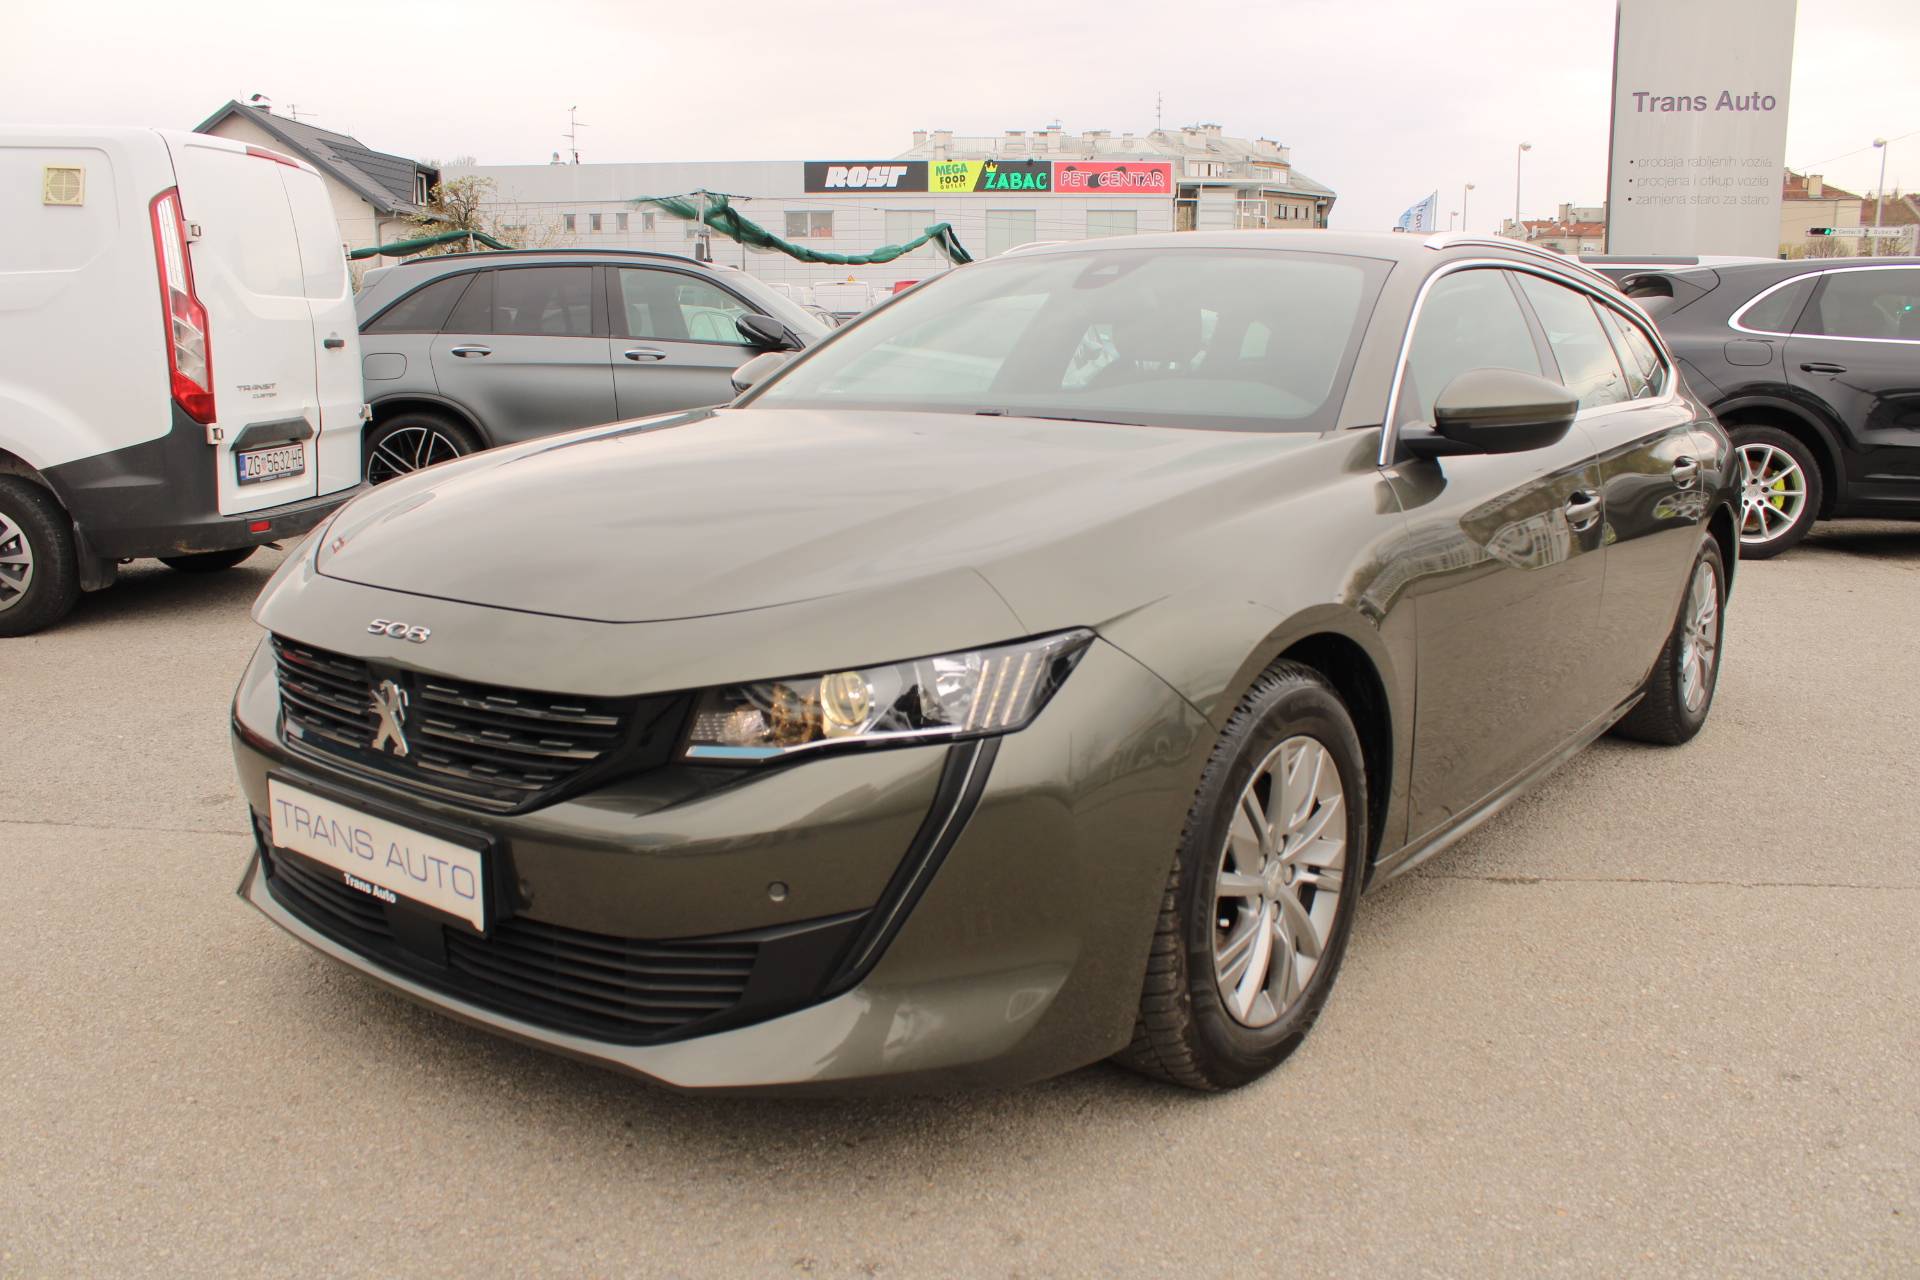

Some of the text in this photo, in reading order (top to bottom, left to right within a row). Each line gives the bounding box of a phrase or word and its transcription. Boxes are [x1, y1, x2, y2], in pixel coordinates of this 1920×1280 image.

[1632, 90, 1776, 113] Trans Auto
[935, 163, 968, 176] MEGA
[1638, 156, 1773, 168] prodaja rabljenih vozila
[824, 166, 907, 188] ROST
[940, 175, 966, 184] FOOD
[1060, 170, 1166, 187] PET CENTAR
[1699, 175, 1734, 188] otkup
[1737, 175, 1769, 187] vozila
[1635, 194, 1770, 206] zamjena staro za staro
[247, 455, 260, 476] ZG
[367, 619, 431, 643] 508
[276, 799, 475, 900] TRANS AUTO
[344, 872, 396, 903] Trans Auto
